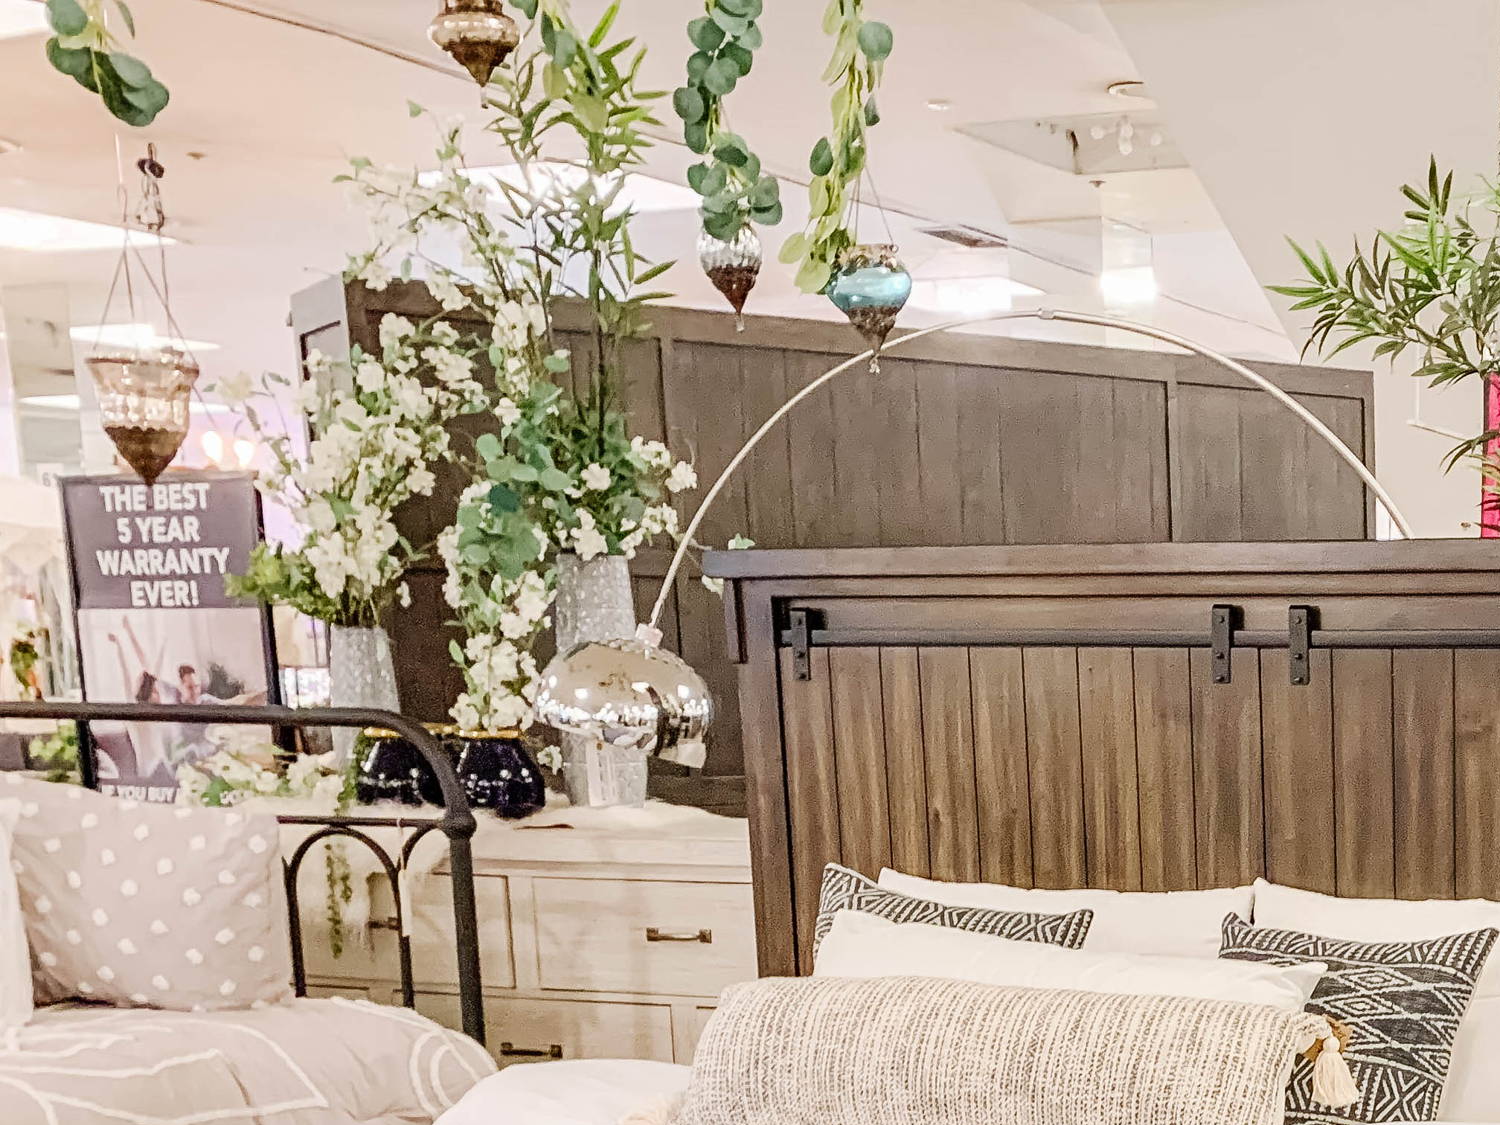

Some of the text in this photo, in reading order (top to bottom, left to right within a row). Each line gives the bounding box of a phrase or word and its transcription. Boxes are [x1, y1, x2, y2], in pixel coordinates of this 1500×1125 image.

[99, 482, 210, 512] THE BEST
[117, 515, 200, 543] 5 YEAR
[96, 547, 230, 576] WARRANTY
[131, 580, 199, 607] EVER!
[117, 786, 147, 801] YOU
